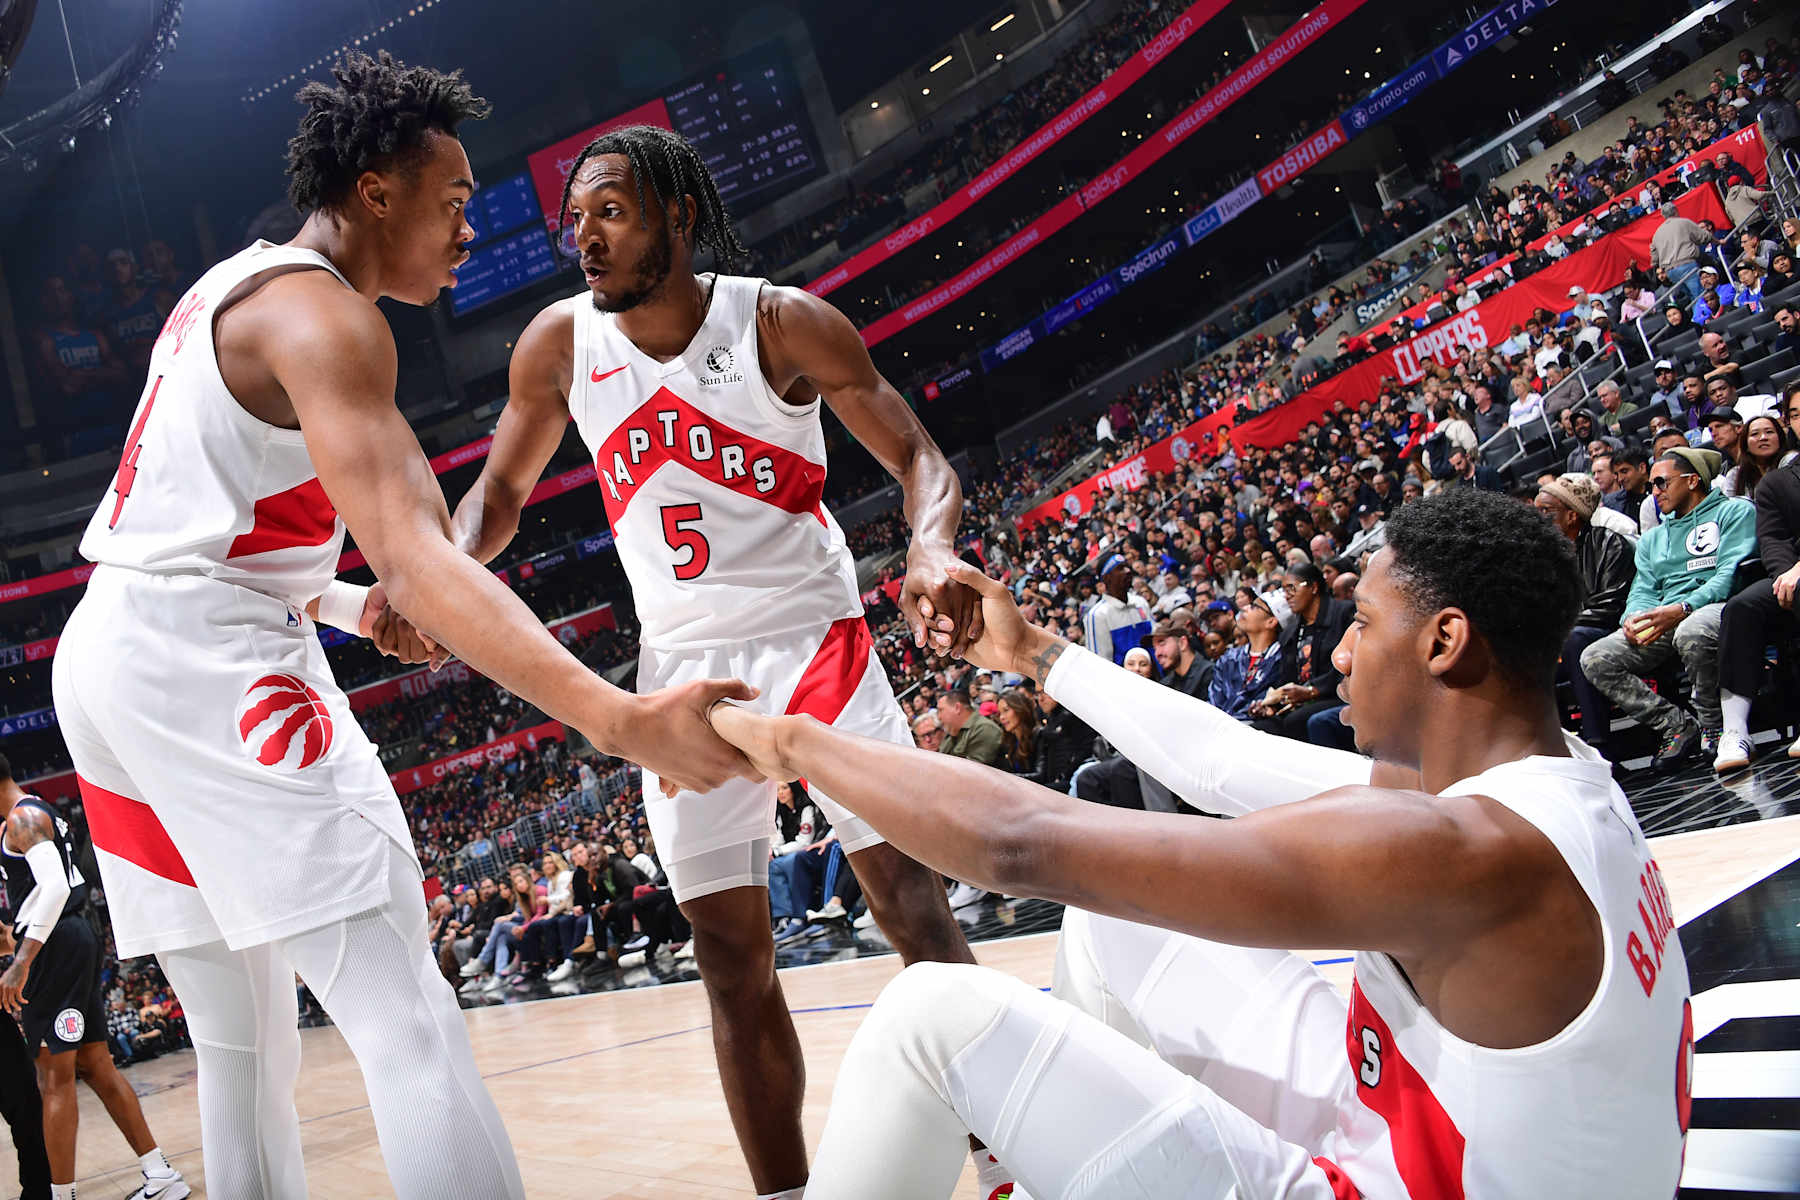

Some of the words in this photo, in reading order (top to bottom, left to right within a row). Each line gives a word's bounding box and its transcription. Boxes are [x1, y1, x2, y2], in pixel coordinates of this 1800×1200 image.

[1165, 101, 1214, 144] WIRELESS
[1214, 60, 1269, 107] COVERAGE
[1268, 12, 1330, 65] SOLUTIONS
[1368, 71, 1427, 115] crypto.com
[968, 161, 1010, 198] WIRELESS
[1009, 129, 1054, 168] COVERAGE
[1055, 90, 1108, 135] SOLUTIONS
[1261, 127, 1341, 189] TOSHIBA
[1735, 128, 1755, 145] 111
[1192, 213, 1217, 235] UCLA
[1219, 187, 1257, 218] Health
[904, 290, 950, 321] WIRELESS
[950, 260, 992, 294] COVERAGE
[992, 229, 1039, 266] SOLUTIONS
[1119, 240, 1177, 283] Spectrum
[1392, 309, 1489, 385] CLIPPERS
[699, 375, 721, 386] Sun
[723, 373, 743, 385] Life
[939, 368, 972, 390] TOYOTA
[602, 410, 776, 503] RAPTORS
[584, 533, 614, 553] Spec
[659, 503, 710, 581] 5
[17, 711, 57, 730] DELT
